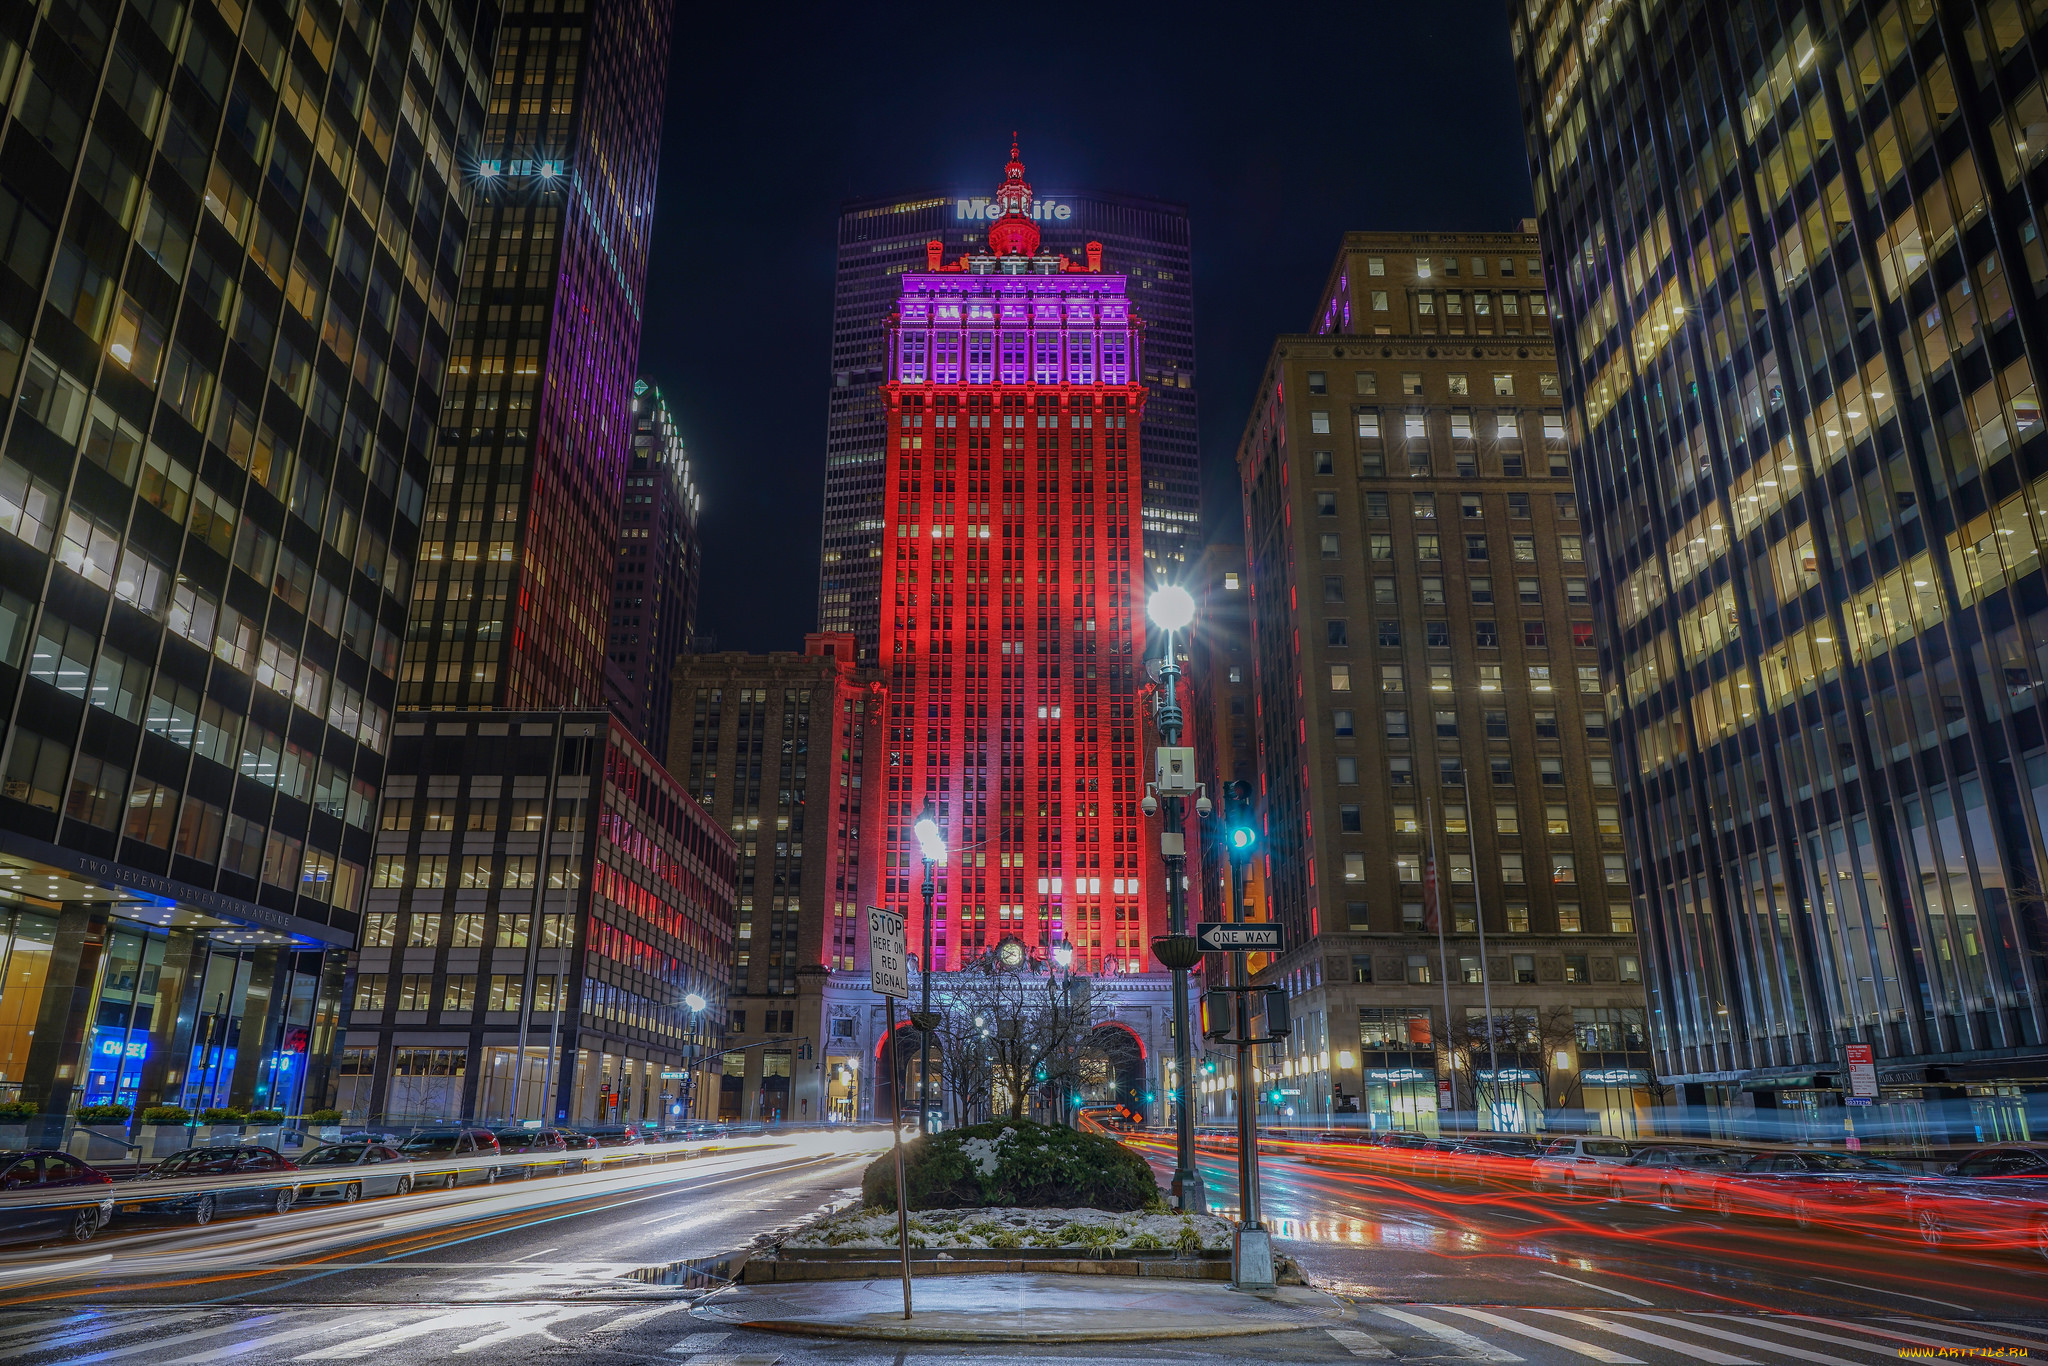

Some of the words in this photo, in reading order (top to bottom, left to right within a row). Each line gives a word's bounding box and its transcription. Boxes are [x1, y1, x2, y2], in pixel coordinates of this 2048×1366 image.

[957, 199, 1071, 220] Meife
[79, 858, 107, 875] TWO
[115, 868, 173, 893] SEVENTY
[179, 887, 215, 905] SEVEN
[220, 899, 247, 914] PARK
[252, 908, 289, 926] AVENUE
[871, 913, 902, 937] STOP
[872, 936, 891, 952] HERE
[894, 941, 903, 956] ON
[1213, 931, 1239, 943] ONE
[1245, 931, 1271, 943] WAY
[882, 955, 898, 970] RED
[875, 971, 906, 990] SIGNAL
[1895, 1072, 1921, 1082] AVENUE
